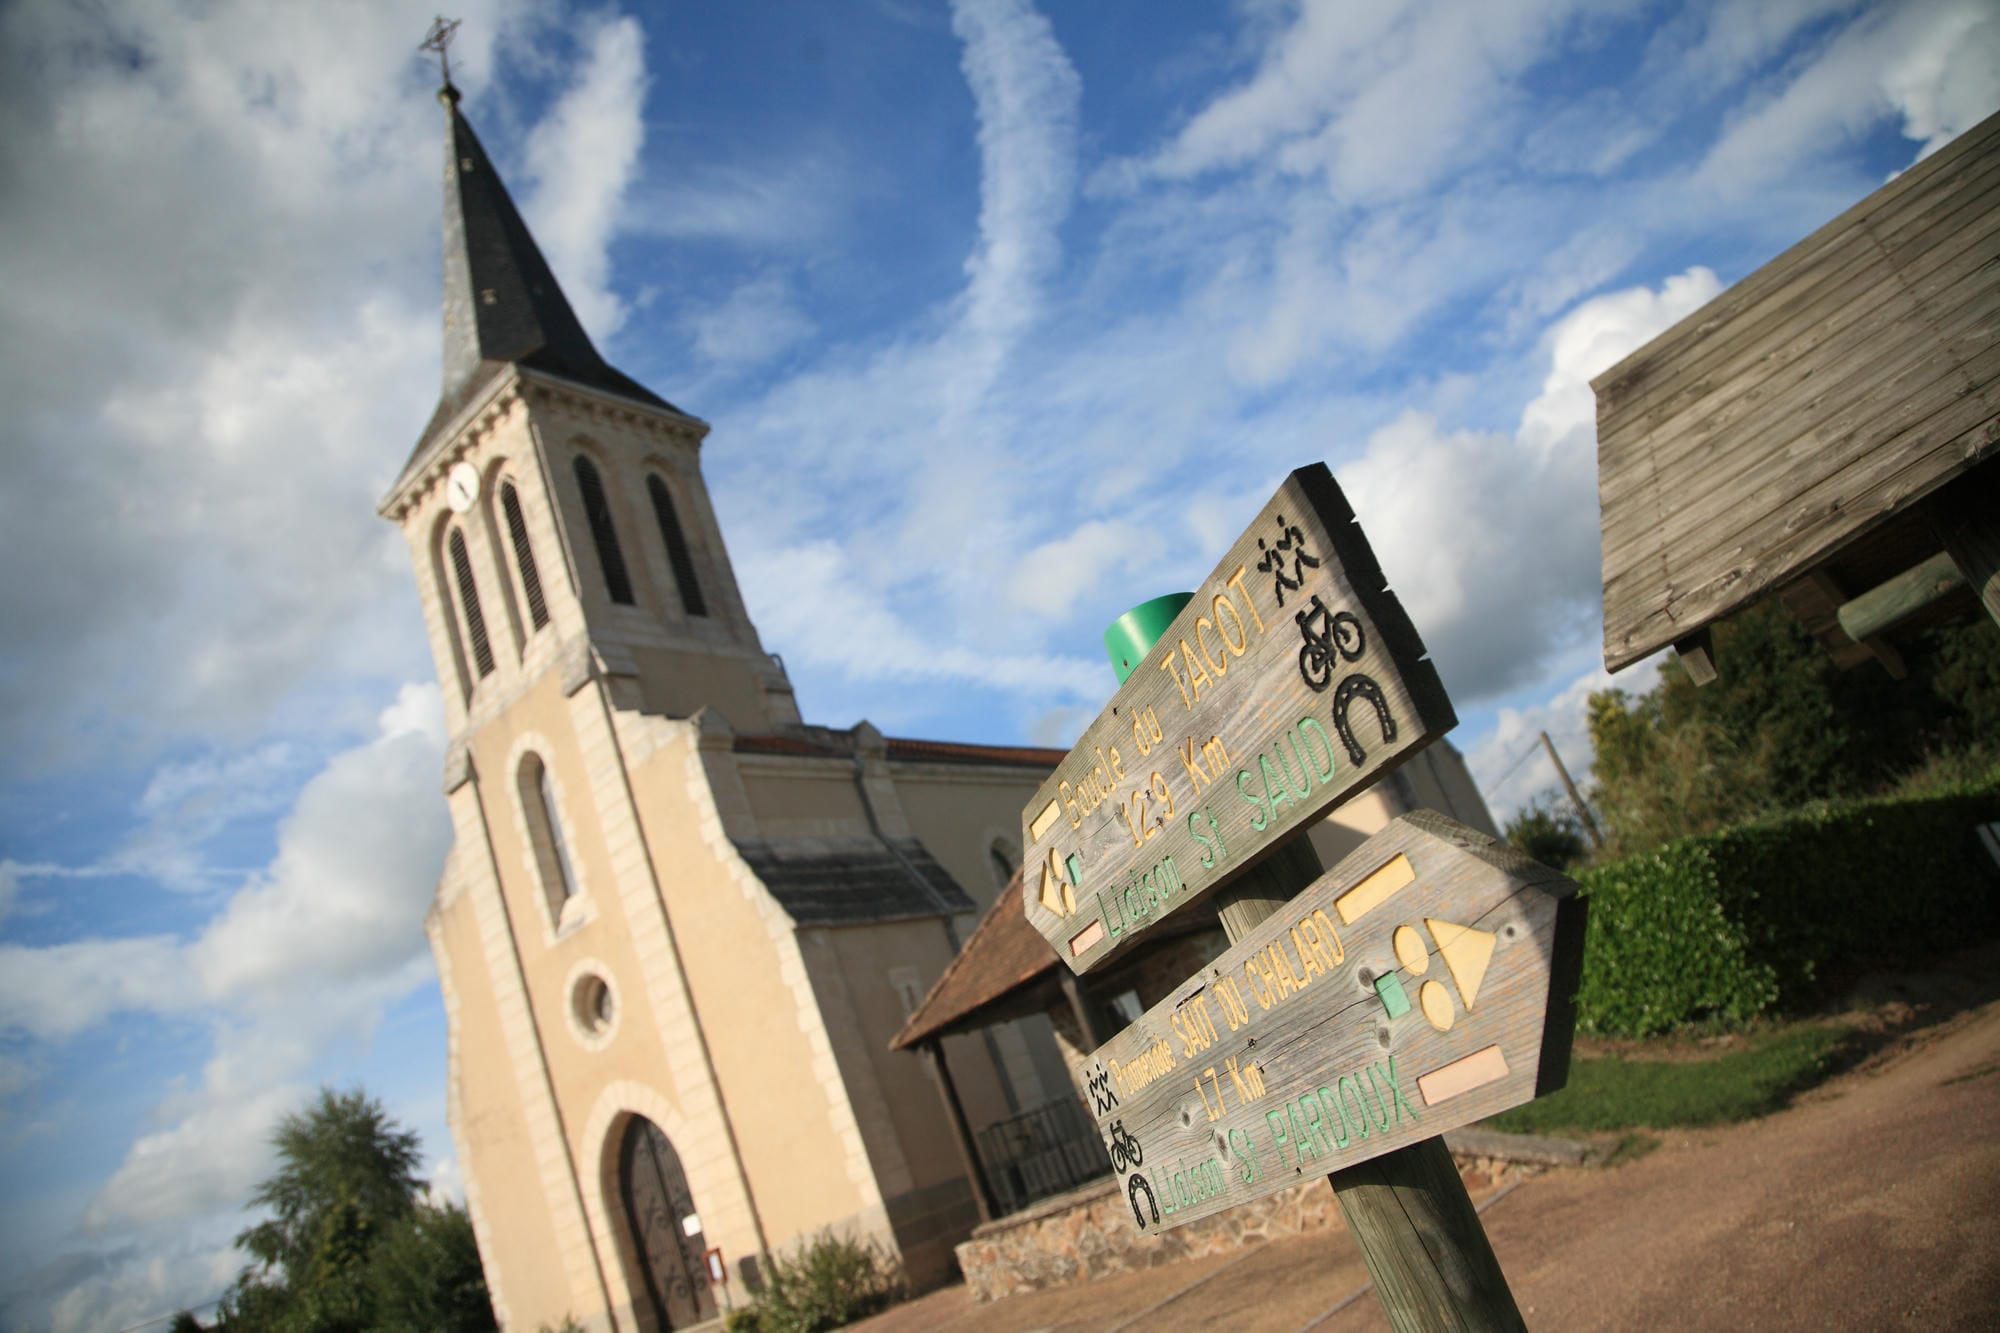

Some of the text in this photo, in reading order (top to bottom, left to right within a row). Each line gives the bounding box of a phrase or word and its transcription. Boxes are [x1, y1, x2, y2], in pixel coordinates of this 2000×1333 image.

[1058, 564, 1265, 831] Boucle du TACOT
[1177, 735, 1232, 796] Km
[1096, 854, 1184, 938] Liaison
[1236, 716, 1336, 832] SAUD
[1170, 993, 1219, 1059] SAUT
[1213, 975, 1249, 1032] DU
[1243, 908, 1345, 1011] CHALARD
[1150, 1157, 1227, 1214] Liaison
[1265, 1055, 1419, 1169] PARDOUX
[1224, 1054, 1266, 1106] Km
